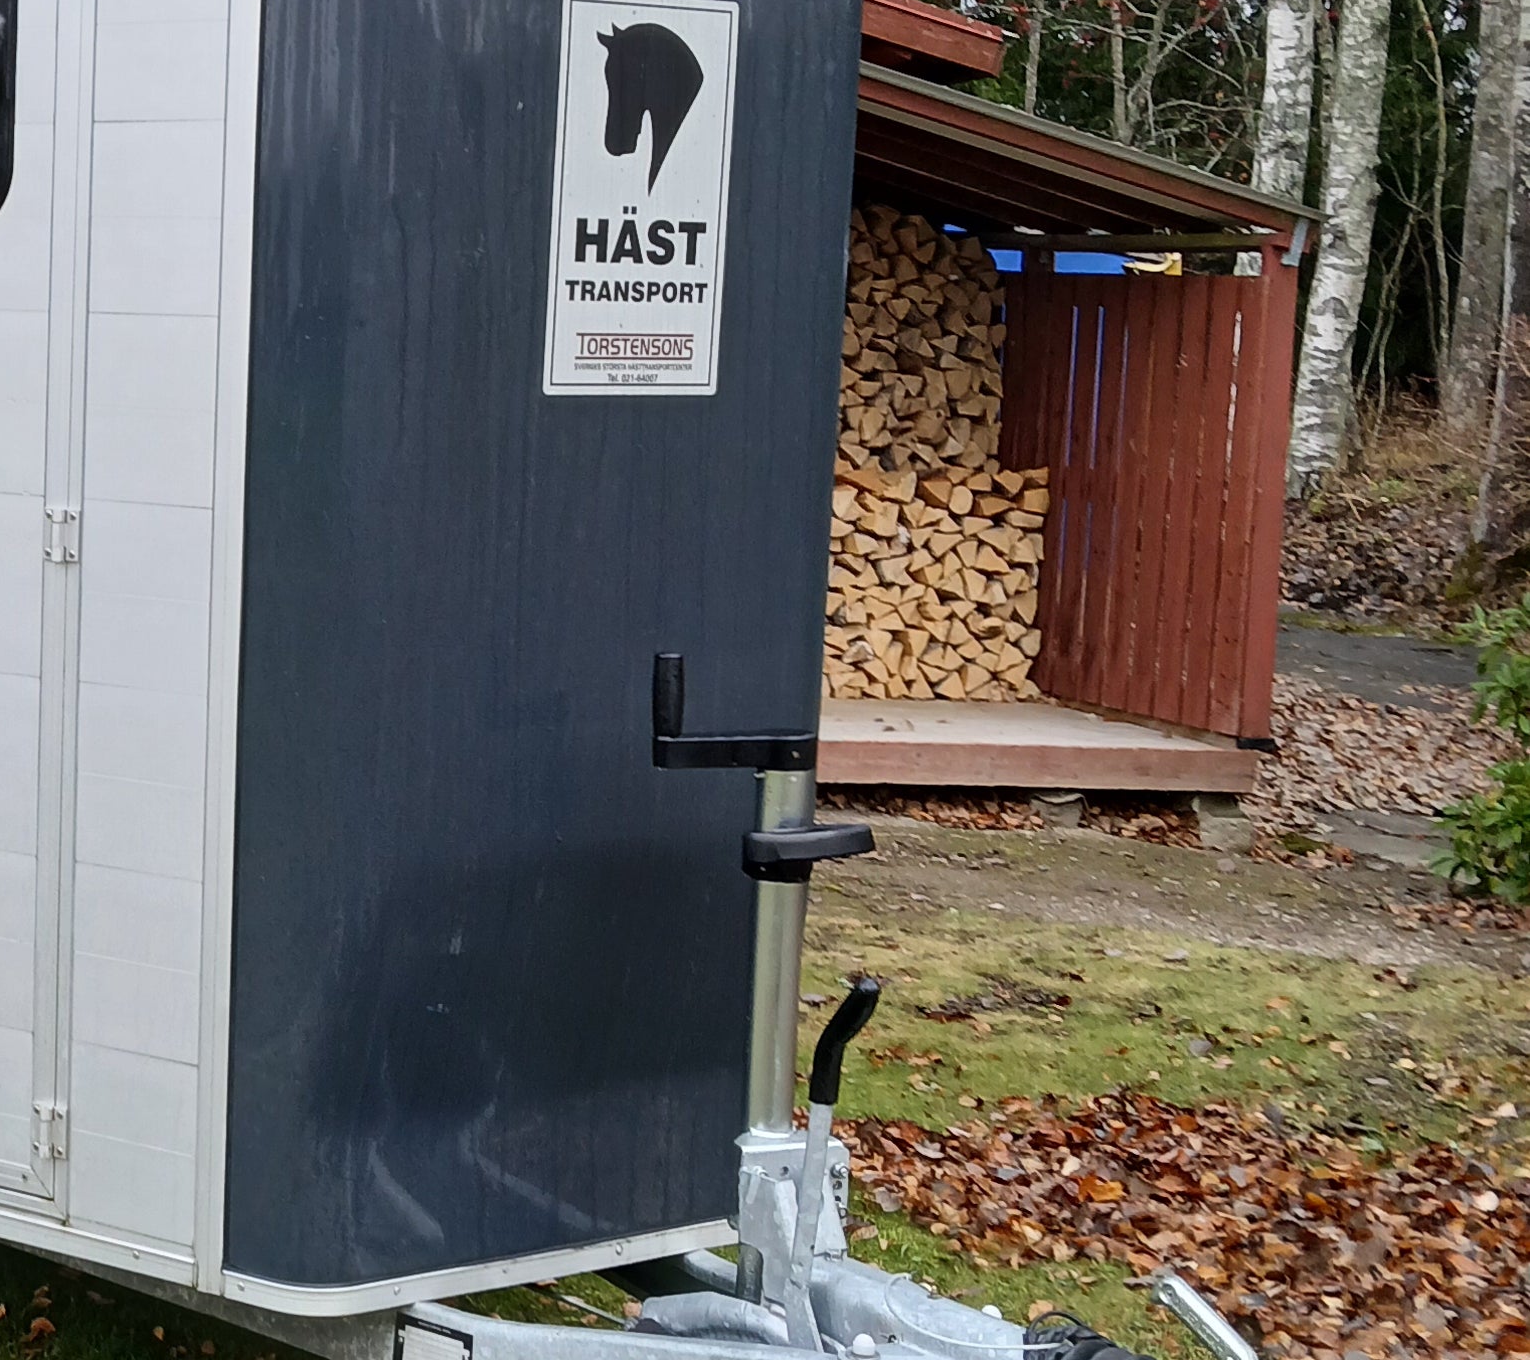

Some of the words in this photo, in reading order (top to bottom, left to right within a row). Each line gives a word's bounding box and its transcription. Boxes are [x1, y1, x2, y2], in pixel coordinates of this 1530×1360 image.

[575, 206, 707, 266] HÄST
[565, 280, 708, 304] TRANSPORT
[575, 332, 694, 360] TORSTENSONS
